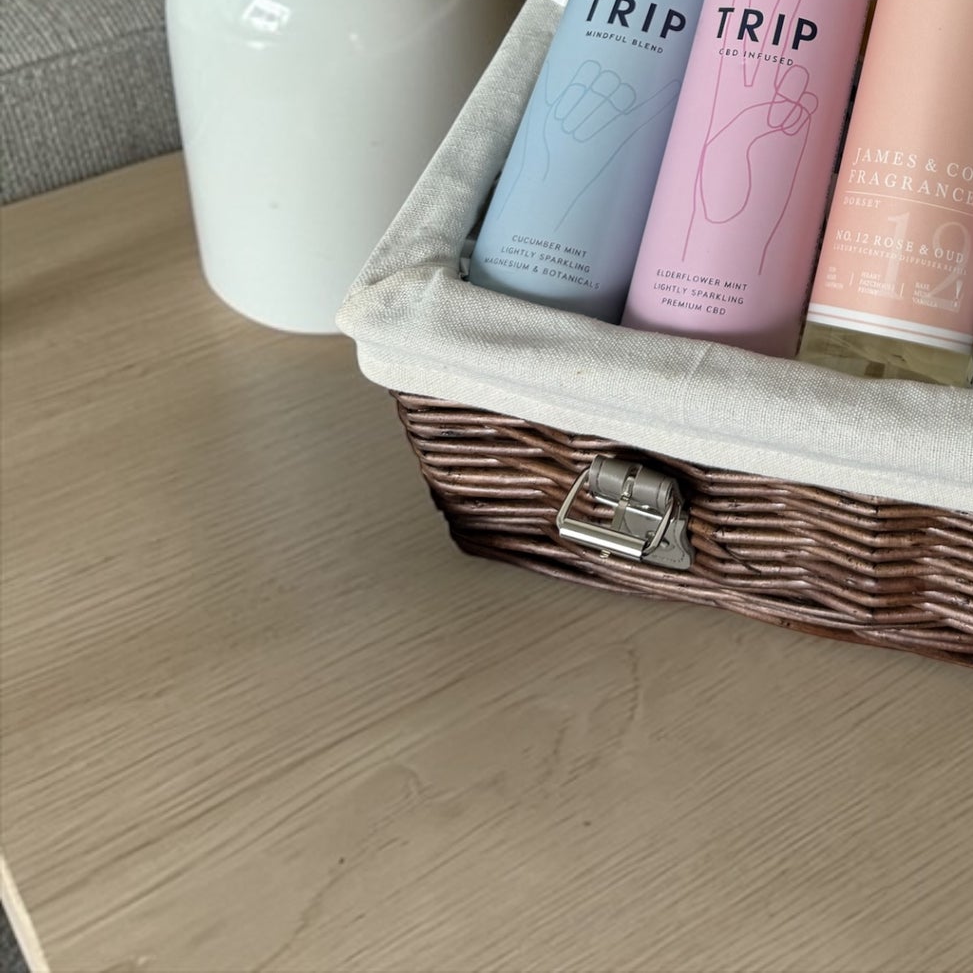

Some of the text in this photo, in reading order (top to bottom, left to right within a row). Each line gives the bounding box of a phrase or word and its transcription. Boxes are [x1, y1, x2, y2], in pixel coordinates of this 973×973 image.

[716, 7, 818, 50] TRIP
[586, 30, 664, 54] MINDFUL BLEND
[719, 48, 794, 66] CBD INFUSED
[852, 147, 973, 182] JAMES & CO
[843, 196, 882, 208] DORSET
[512, 234, 587, 258] CUCUMBER MINT
[856, 232, 869, 243] 12
[874, 235, 914, 252] ROSE
[919, 244, 929, 256] &
[934, 248, 964, 263] OUD
[501, 246, 591, 273] LIGHTLY SPARKLING
[484, 257, 530, 270] MAGNESIUM
[542, 268, 600, 289] BOTANICALS
[657, 269, 748, 291] ELDERFLOWER MINT
[653, 282, 744, 305] LIGHTLY SPARKLING
[661, 297, 726, 315] PREMIUM CBD
